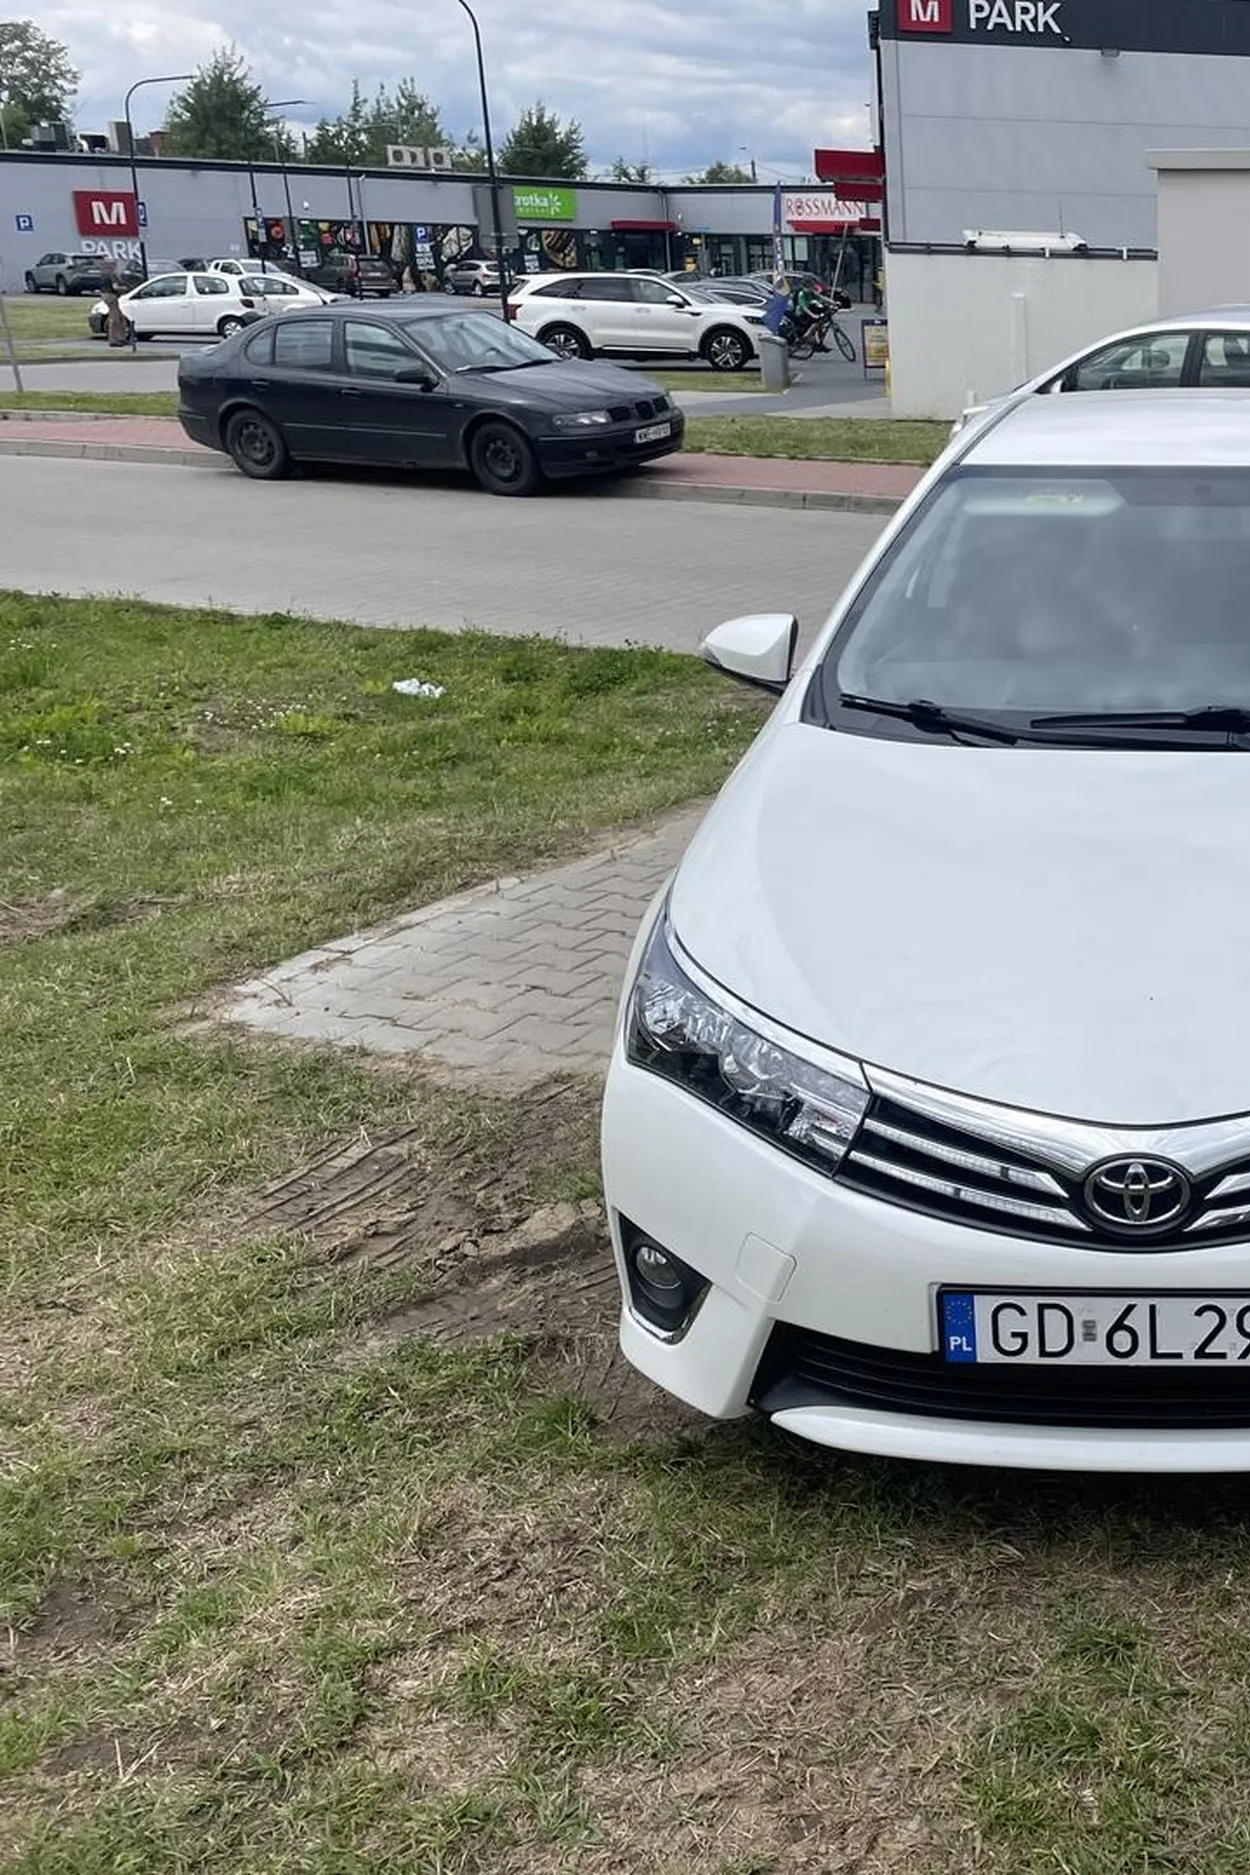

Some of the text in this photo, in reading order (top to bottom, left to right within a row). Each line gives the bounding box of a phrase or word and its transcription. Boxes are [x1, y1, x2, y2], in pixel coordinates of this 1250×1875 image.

[968, 0, 1062, 34] PARK
[91, 201, 127, 225] M
[786, 198, 864, 216] ROSSMANN
[81, 240, 141, 262] PARK
[991, 1302, 1075, 1360] GD
[949, 1335, 973, 1352] PL
